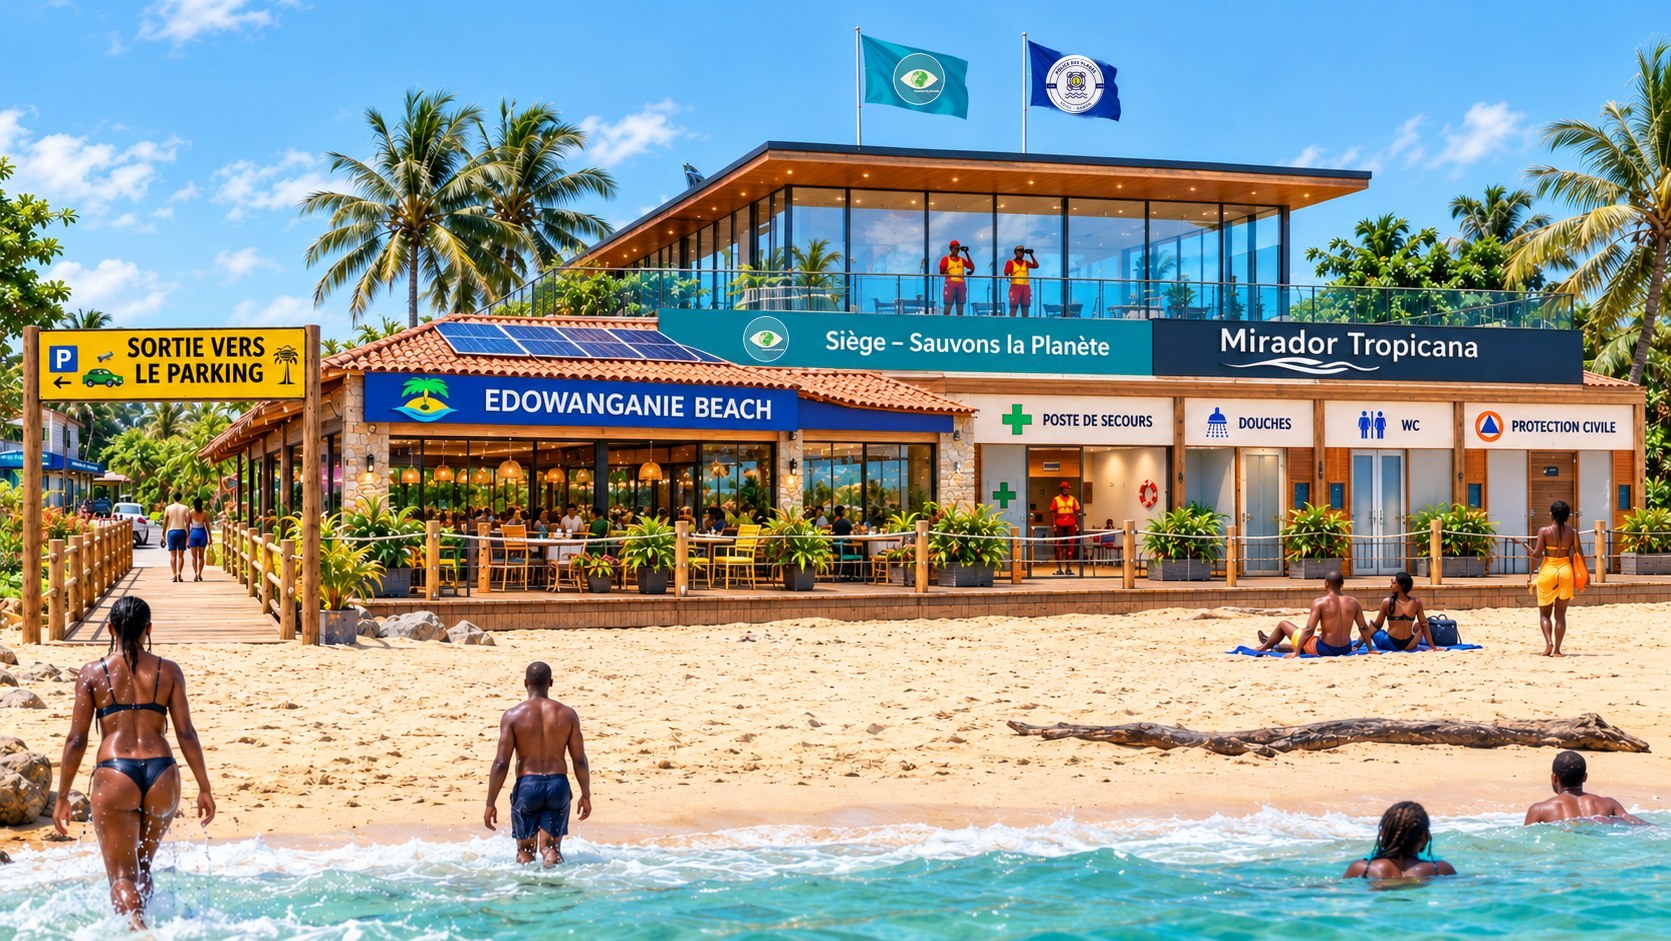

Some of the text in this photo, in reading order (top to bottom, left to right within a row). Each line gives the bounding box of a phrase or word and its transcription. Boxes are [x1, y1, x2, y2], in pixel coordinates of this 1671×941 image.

[127, 336, 266, 358] SORTIE VERS
[827, 330, 885, 356] Siège
[909, 332, 1001, 354] Sauvons
[1007, 334, 1025, 355] la
[1032, 335, 1110, 356] Planète
[1221, 328, 1479, 363] Mirador Tropicana
[56, 349, 72, 369] P
[135, 362, 264, 384] LE PARKING
[485, 388, 772, 420] EDOWANGANIE BEACH
[1042, 413, 1153, 428] POSTE DE SECOURS
[1238, 416, 1292, 430] DOUCHES
[1401, 419, 1420, 432] WC
[1511, 419, 1617, 434] PROTECTION CIVILE
